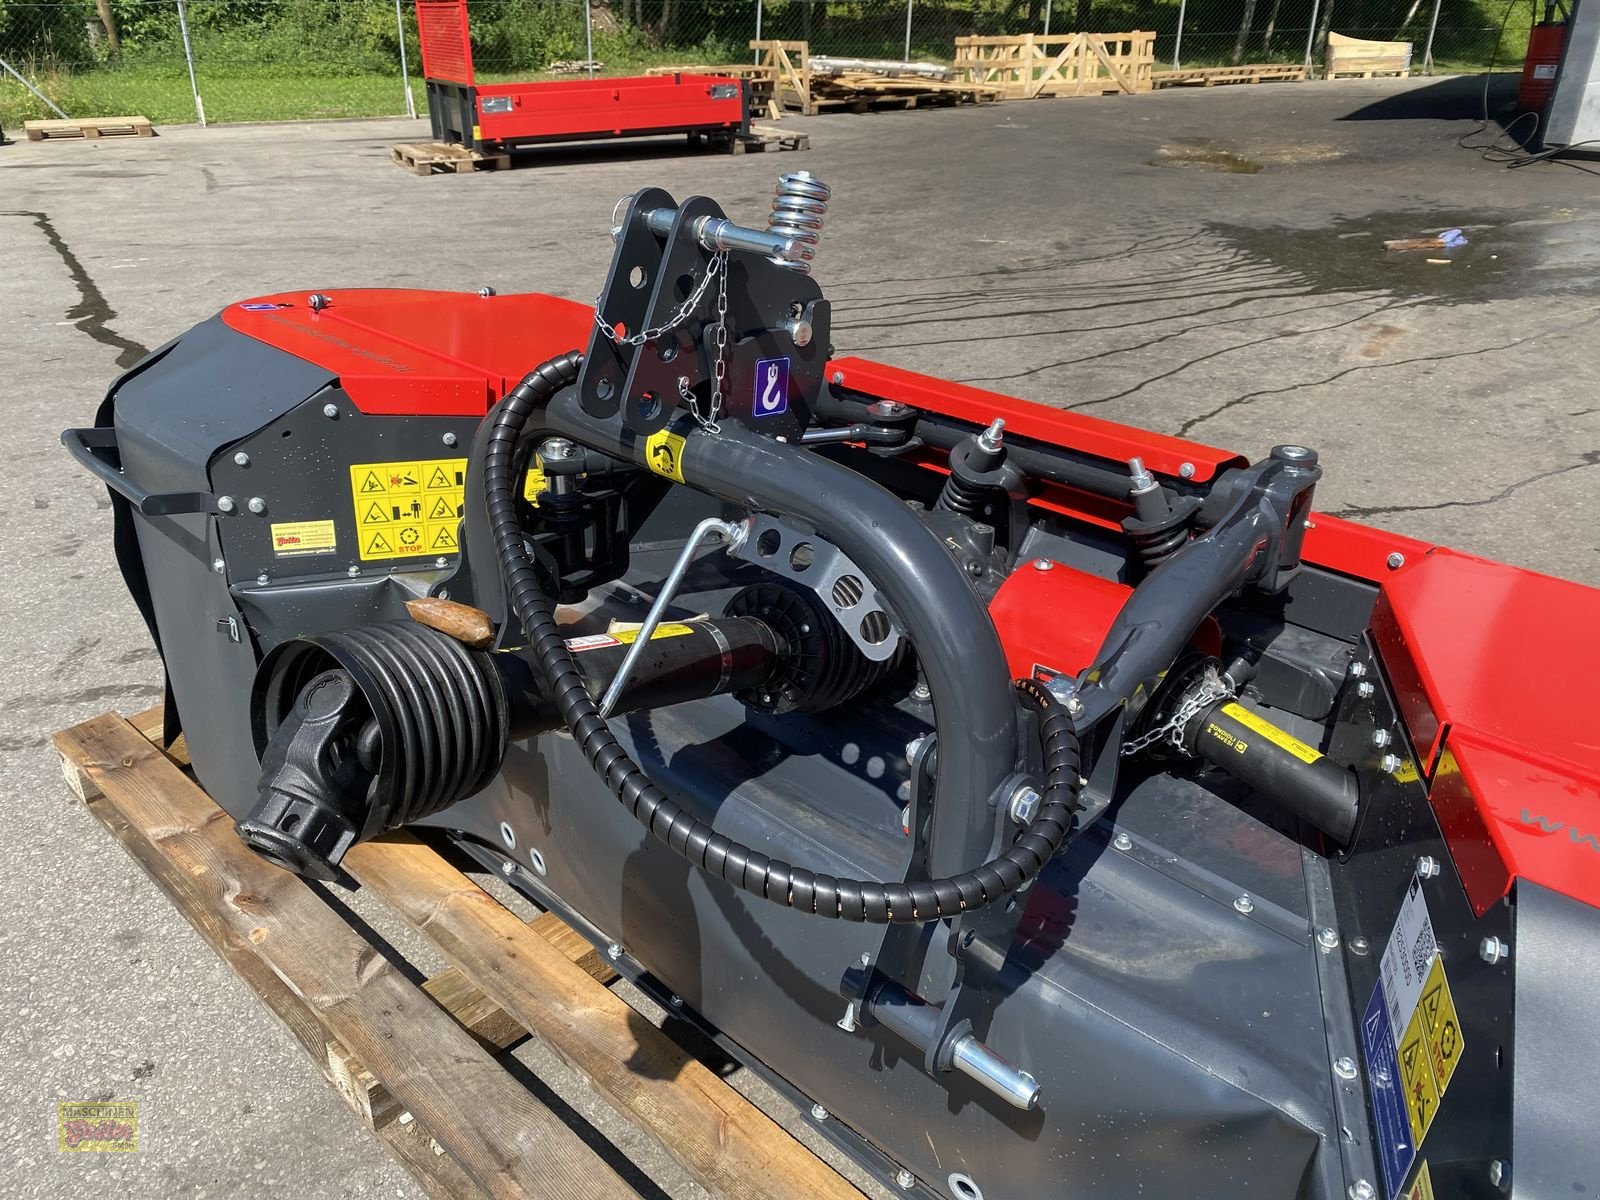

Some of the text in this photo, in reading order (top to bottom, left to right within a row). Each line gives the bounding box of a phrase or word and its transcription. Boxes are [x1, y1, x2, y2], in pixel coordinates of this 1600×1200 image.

[398, 545, 422, 553] STOP
[1209, 722, 1237, 743] BONDIOLI
[1213, 731, 1234, 747] PAVESI
[1432, 1041, 1446, 1079] STOP
